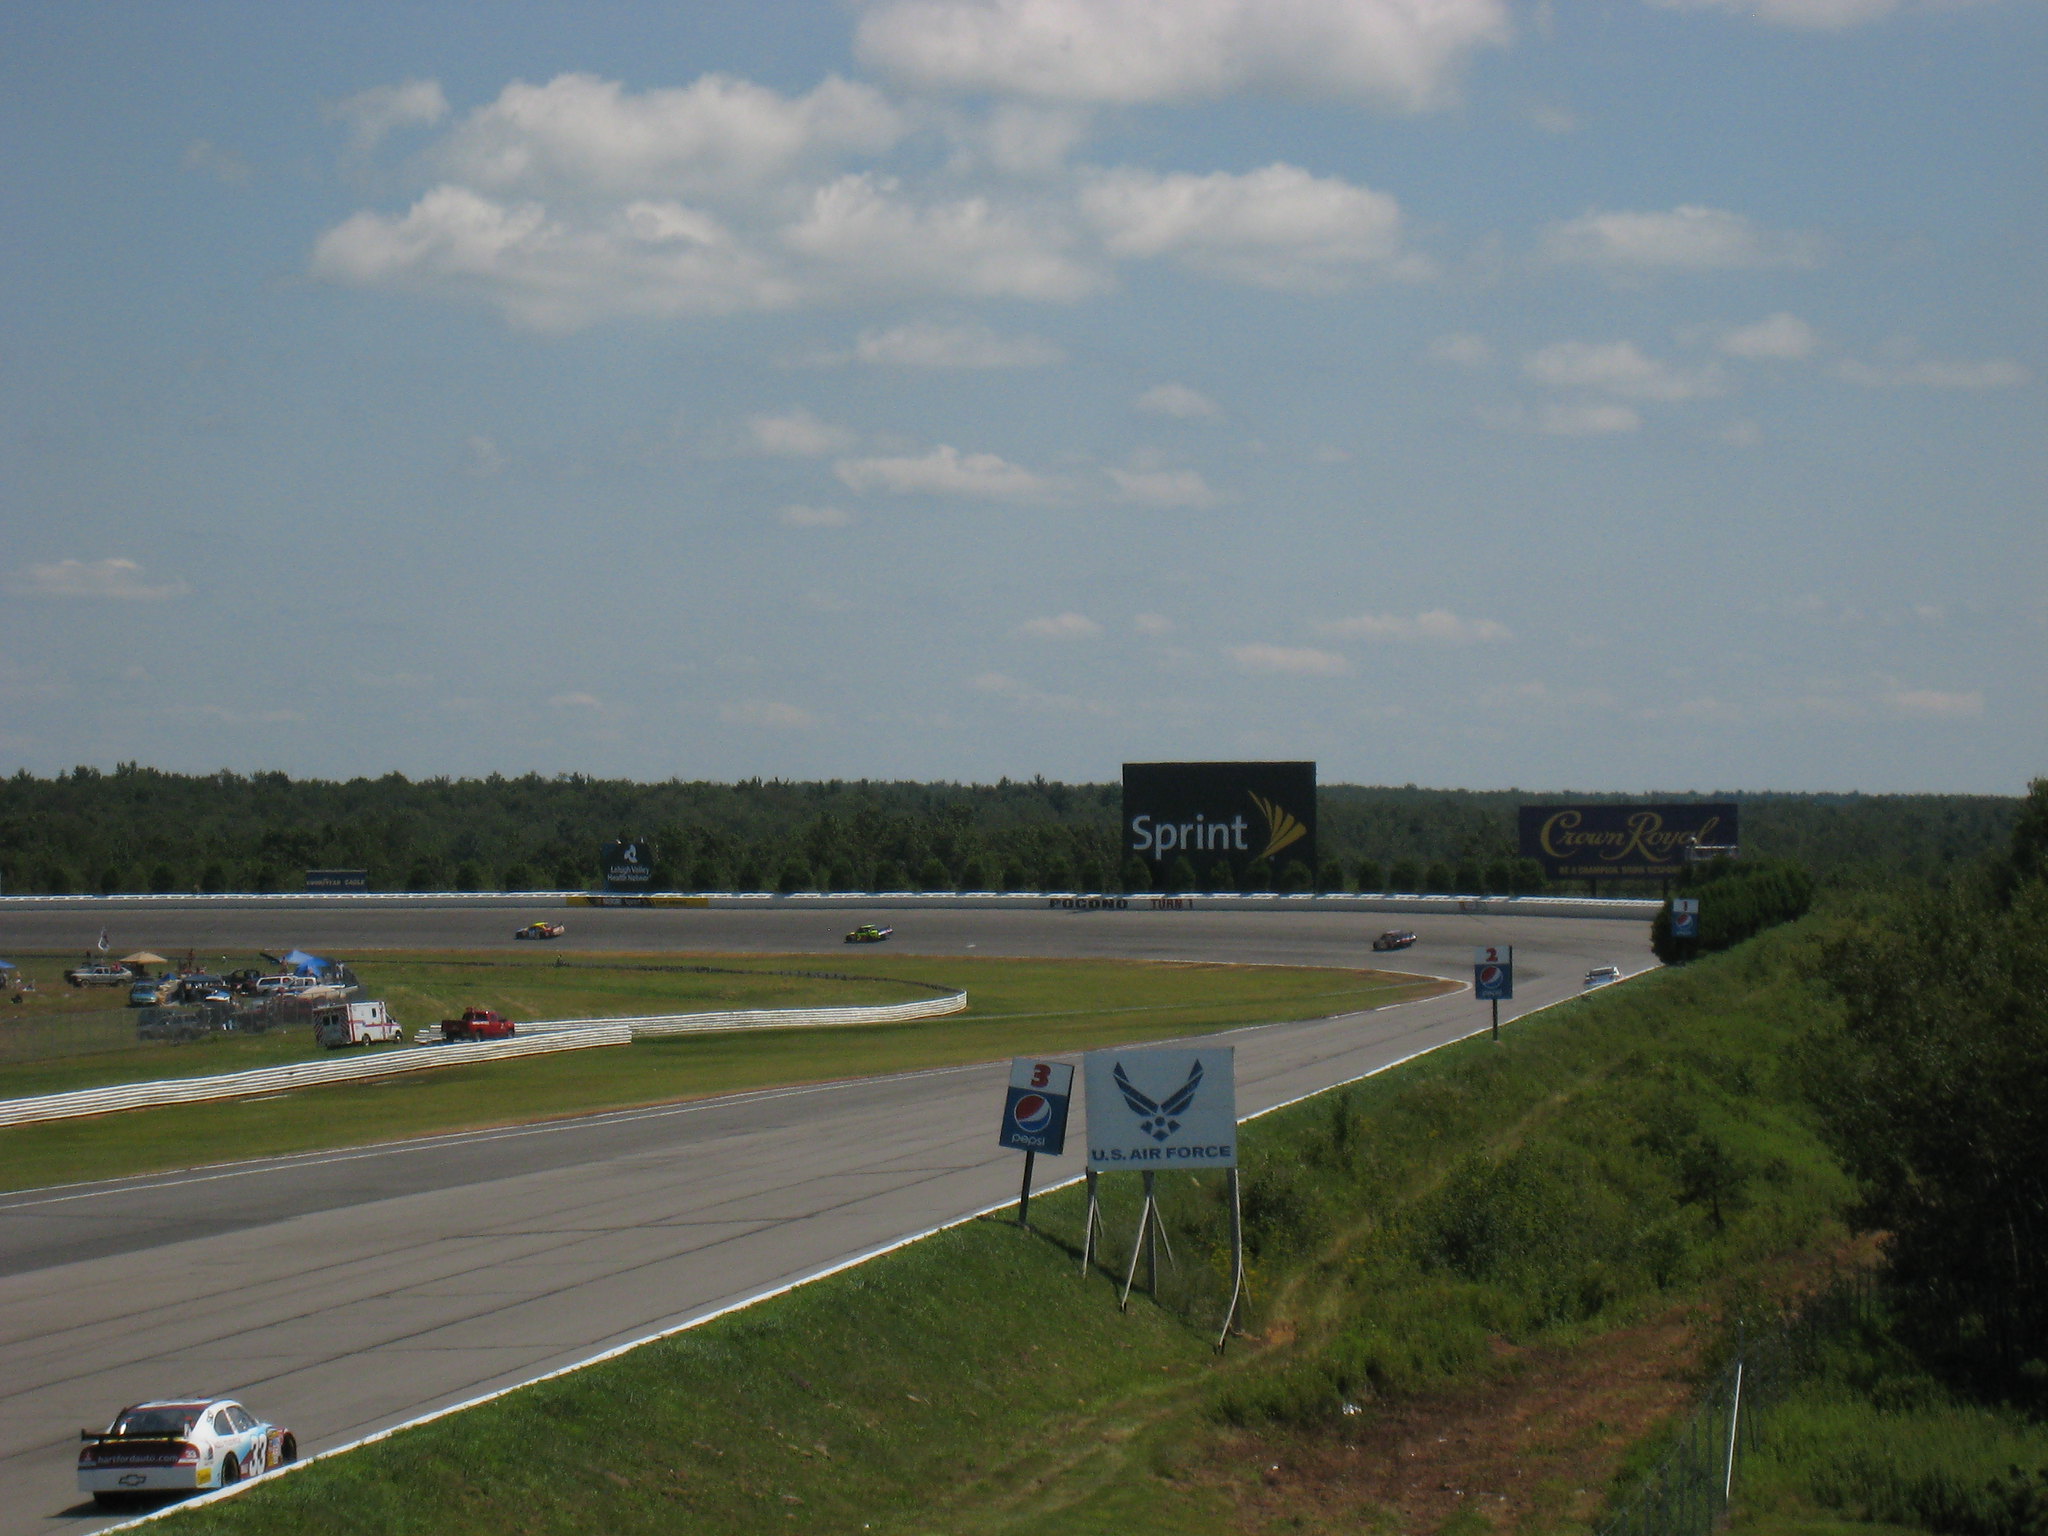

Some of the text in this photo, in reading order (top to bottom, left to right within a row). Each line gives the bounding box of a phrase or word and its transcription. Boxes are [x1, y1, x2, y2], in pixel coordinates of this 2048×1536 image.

[1132, 814, 1248, 860] Sprint
[1540, 809, 1720, 862] Crown Royal
[1049, 898, 1129, 909] POCONO
[1151, 899, 1183, 910] TURN
[1681, 901, 1688, 911] 1
[1486, 947, 1499, 962] 2
[1030, 1063, 1052, 1088] 3
[1011, 1132, 1046, 1148] pepsi
[1091, 1145, 1232, 1161] U.S. AIR FORCE
[97, 1454, 179, 1464] hartfordauto.com
[249, 1433, 268, 1478] 33
